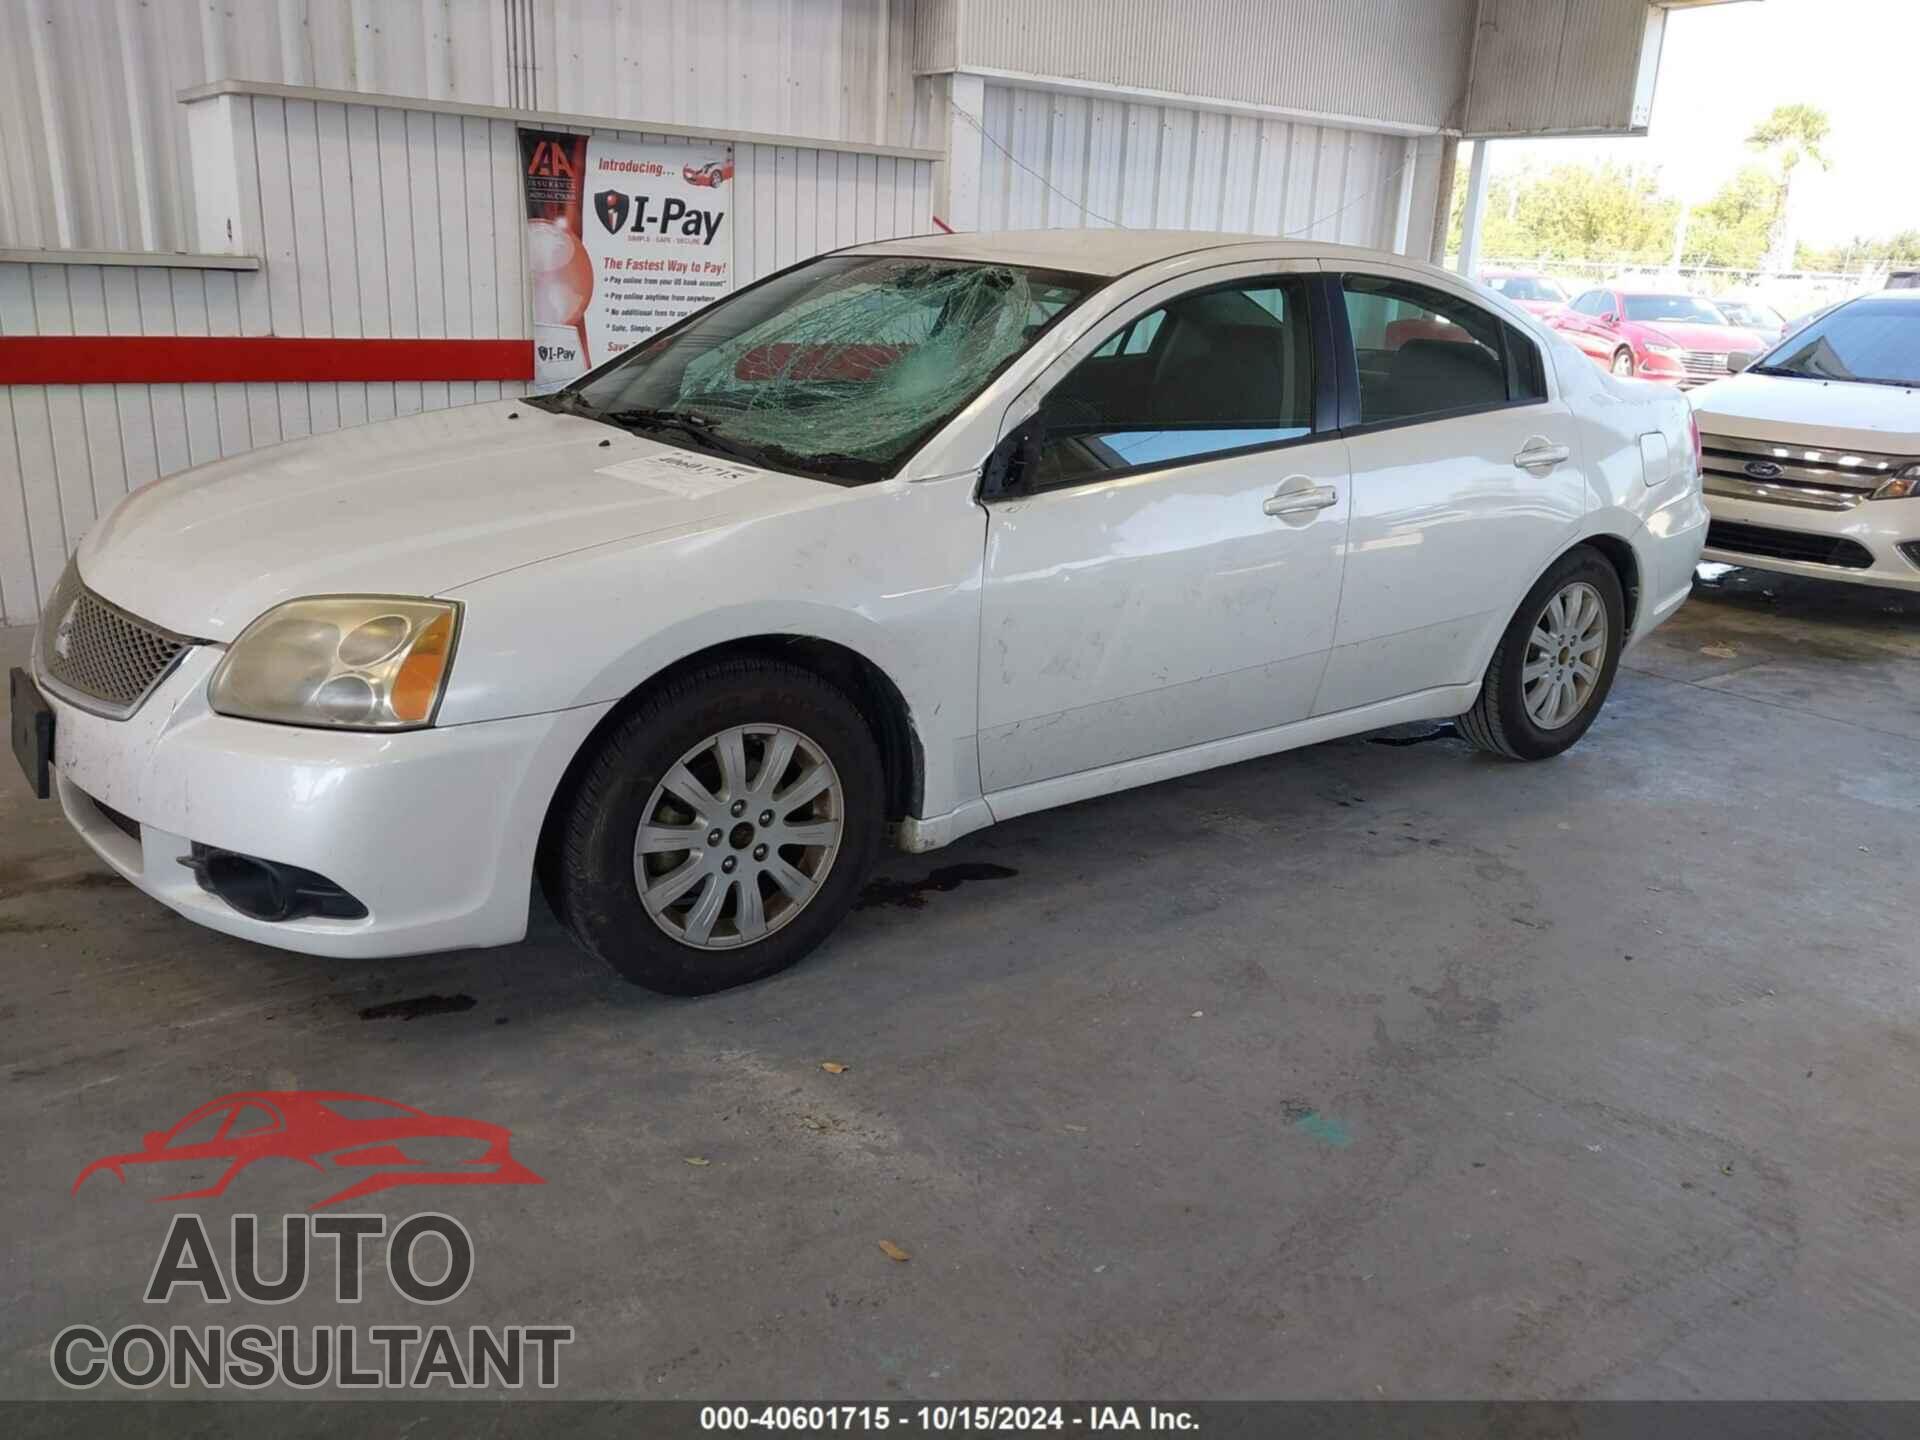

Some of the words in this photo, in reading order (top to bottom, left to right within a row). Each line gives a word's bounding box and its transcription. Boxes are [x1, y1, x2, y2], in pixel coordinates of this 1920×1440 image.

[598, 158, 675, 176] Introducing...
[630, 195, 725, 246] I-Pay
[604, 256, 623, 270] The
[626, 258, 665, 271] Fastest
[668, 259, 688, 274] Way
[691, 261, 701, 272] to
[704, 261, 726, 276] Pay!
[610, 276, 621, 285] Pay
[610, 292, 622, 300] Pay
[645, 293, 669, 302] anytime
[621, 308, 653, 316] additional
[549, 347, 576, 361] I-Pay
